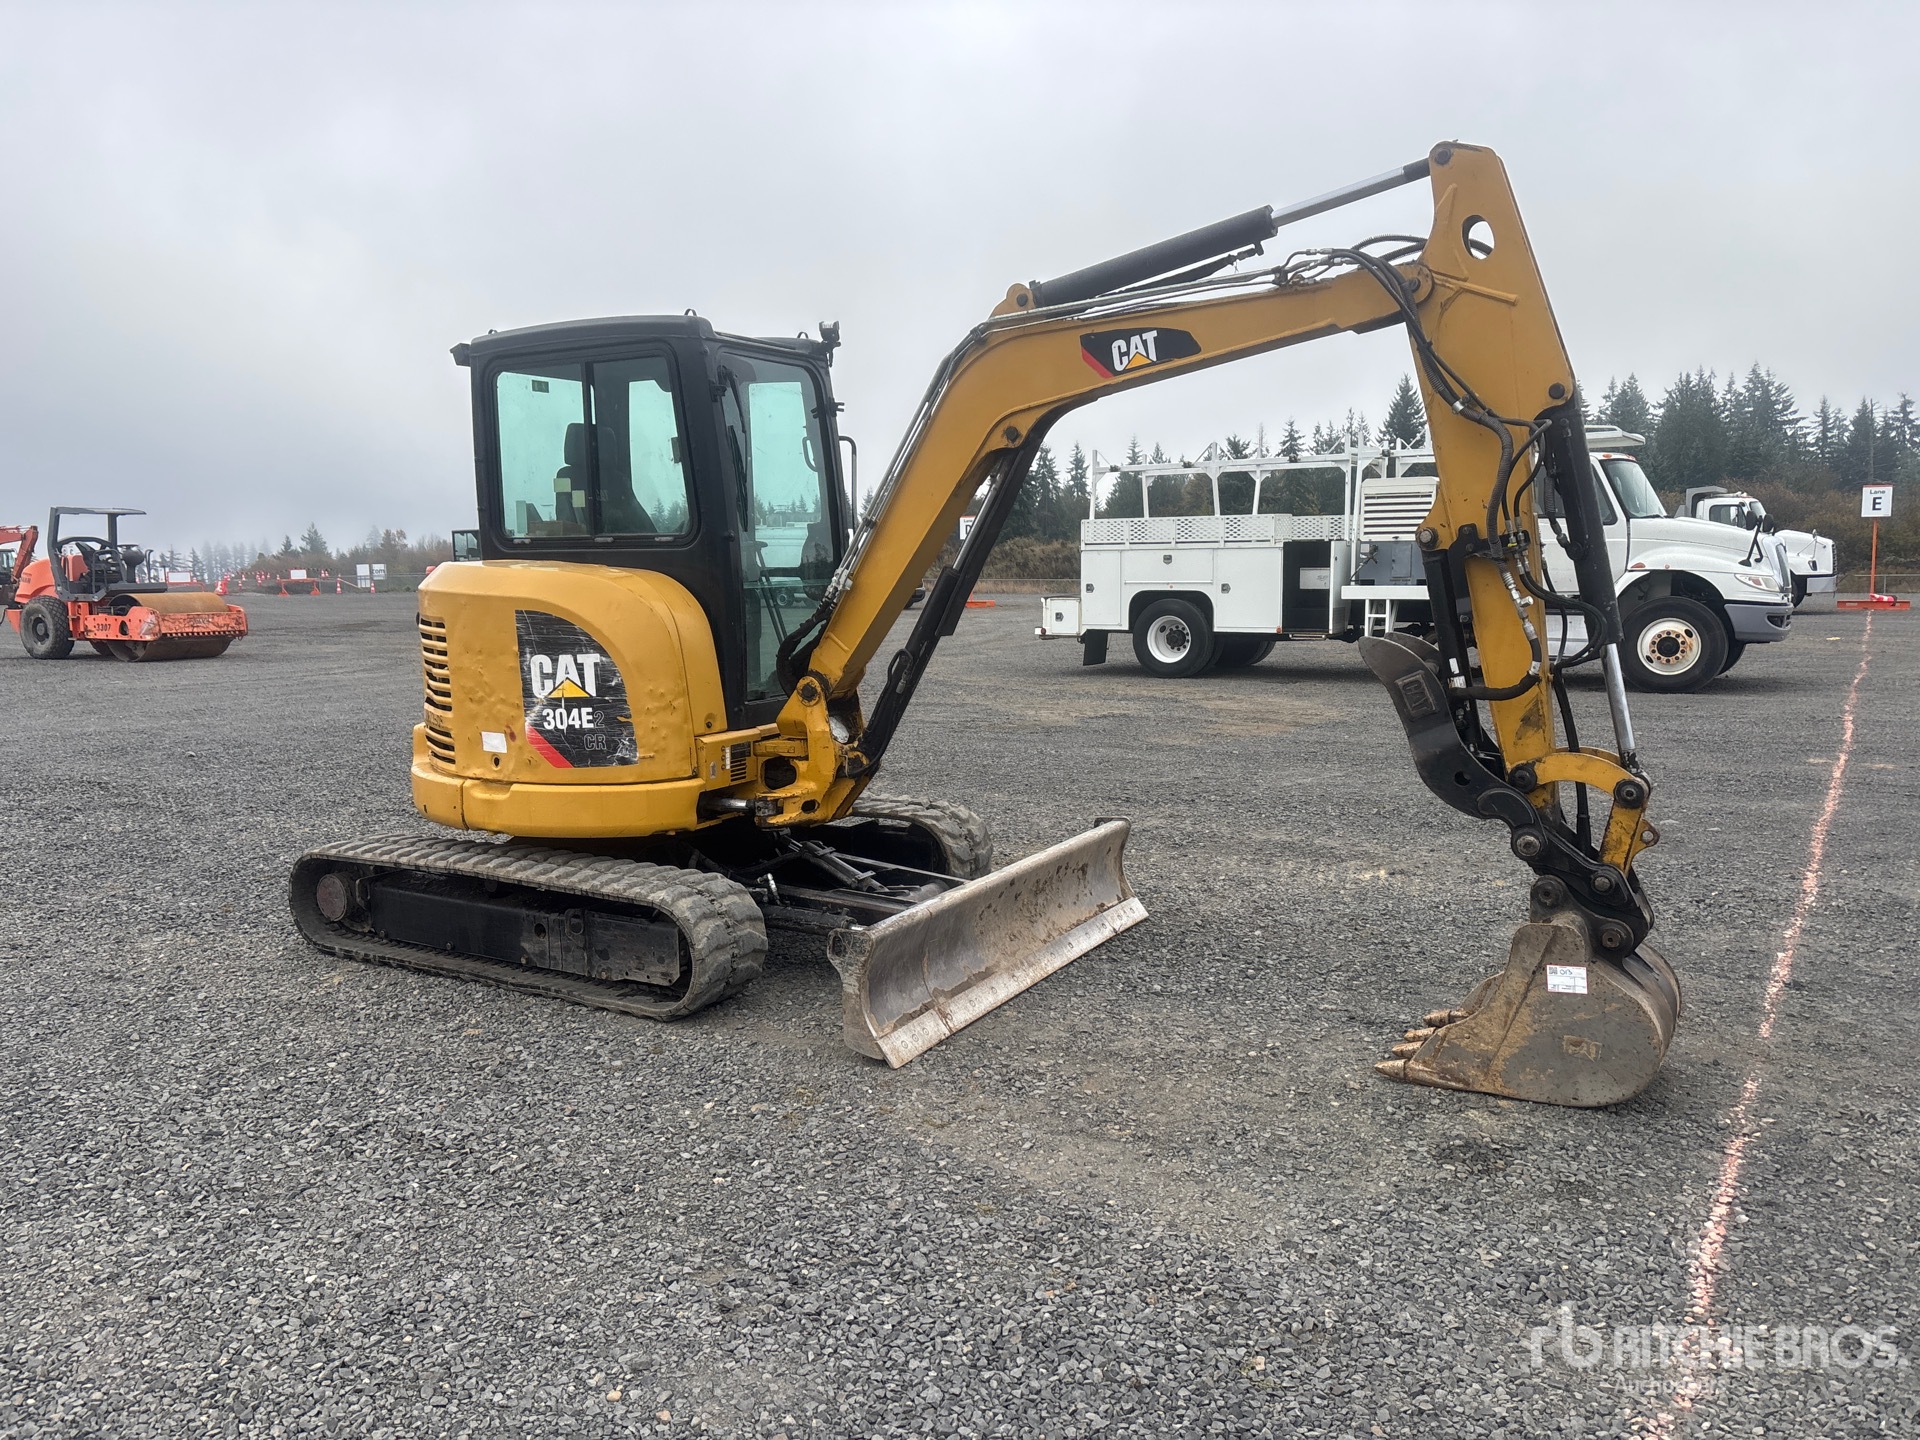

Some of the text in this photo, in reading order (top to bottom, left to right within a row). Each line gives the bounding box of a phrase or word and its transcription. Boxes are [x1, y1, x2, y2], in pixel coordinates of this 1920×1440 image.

[1111, 330, 1158, 371] CAT
[1872, 497, 1882, 510] E
[530, 653, 600, 698] CAT
[583, 734, 607, 750] CR
